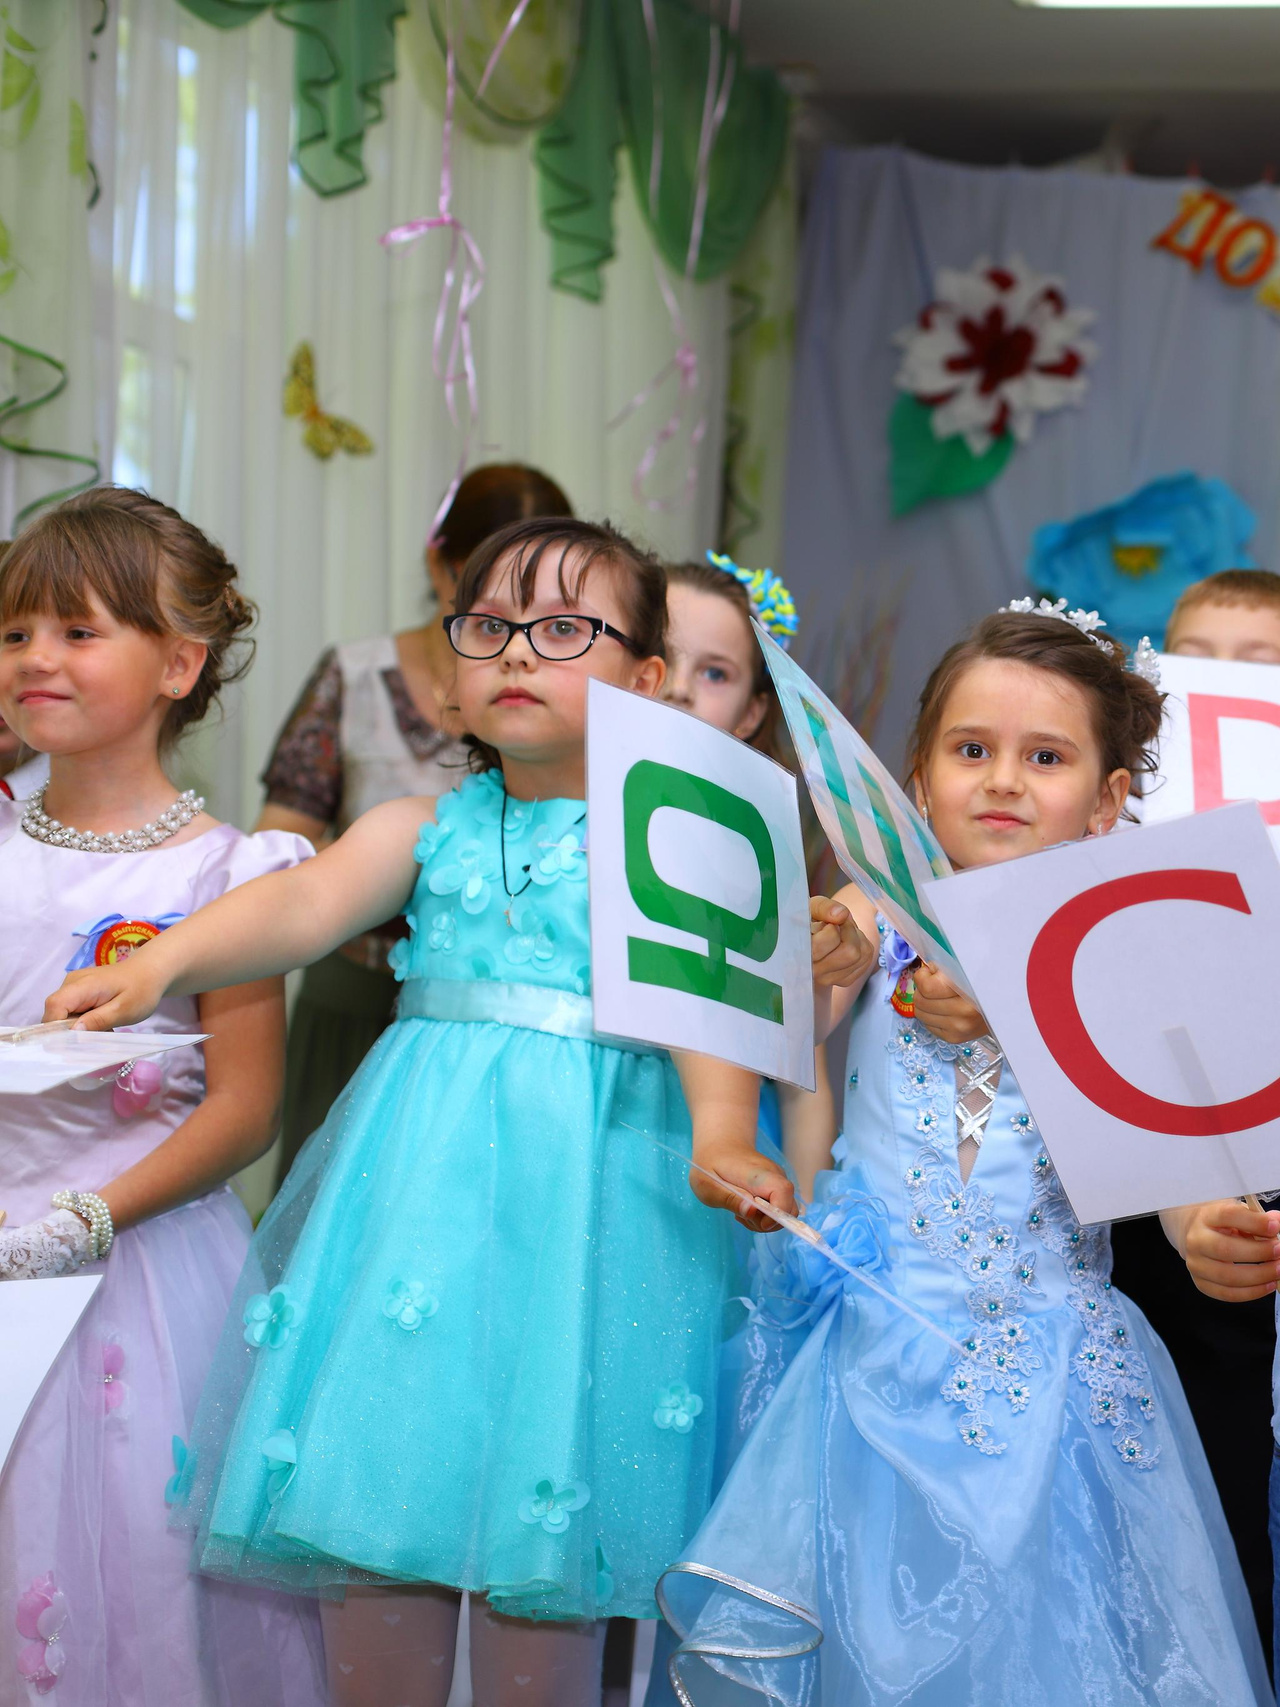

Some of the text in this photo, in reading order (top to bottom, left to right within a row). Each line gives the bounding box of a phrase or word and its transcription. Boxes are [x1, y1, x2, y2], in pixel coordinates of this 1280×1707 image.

[1151, 190, 1279, 288] ДО
[111, 925, 156, 939] ВЫПУСКН
[624, 759, 784, 1025] Ю
